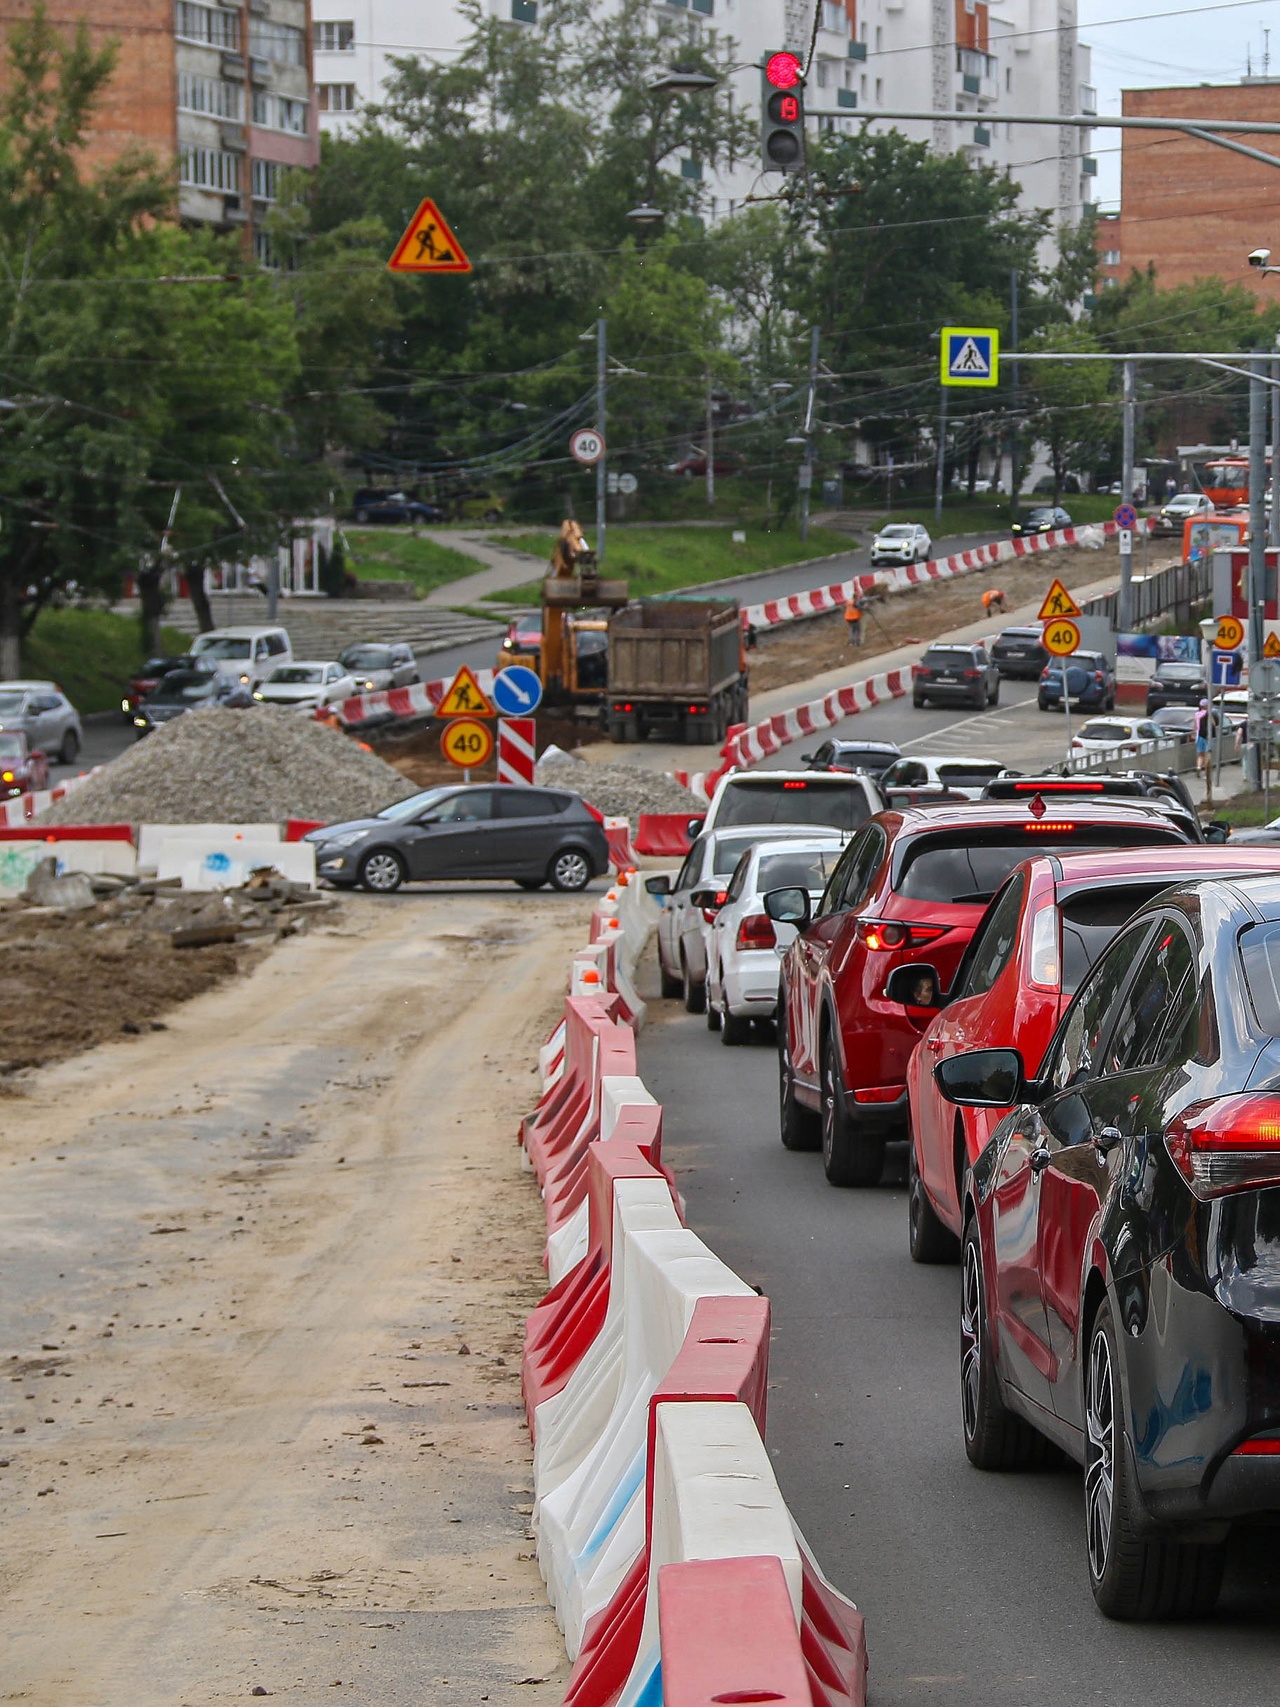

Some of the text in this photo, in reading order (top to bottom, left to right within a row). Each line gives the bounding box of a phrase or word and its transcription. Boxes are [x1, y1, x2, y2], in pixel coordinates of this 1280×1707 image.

[577, 440, 598, 453] 40
[1051, 629, 1074, 645] 40
[1216, 625, 1238, 640] 40
[452, 733, 483, 753] 40
